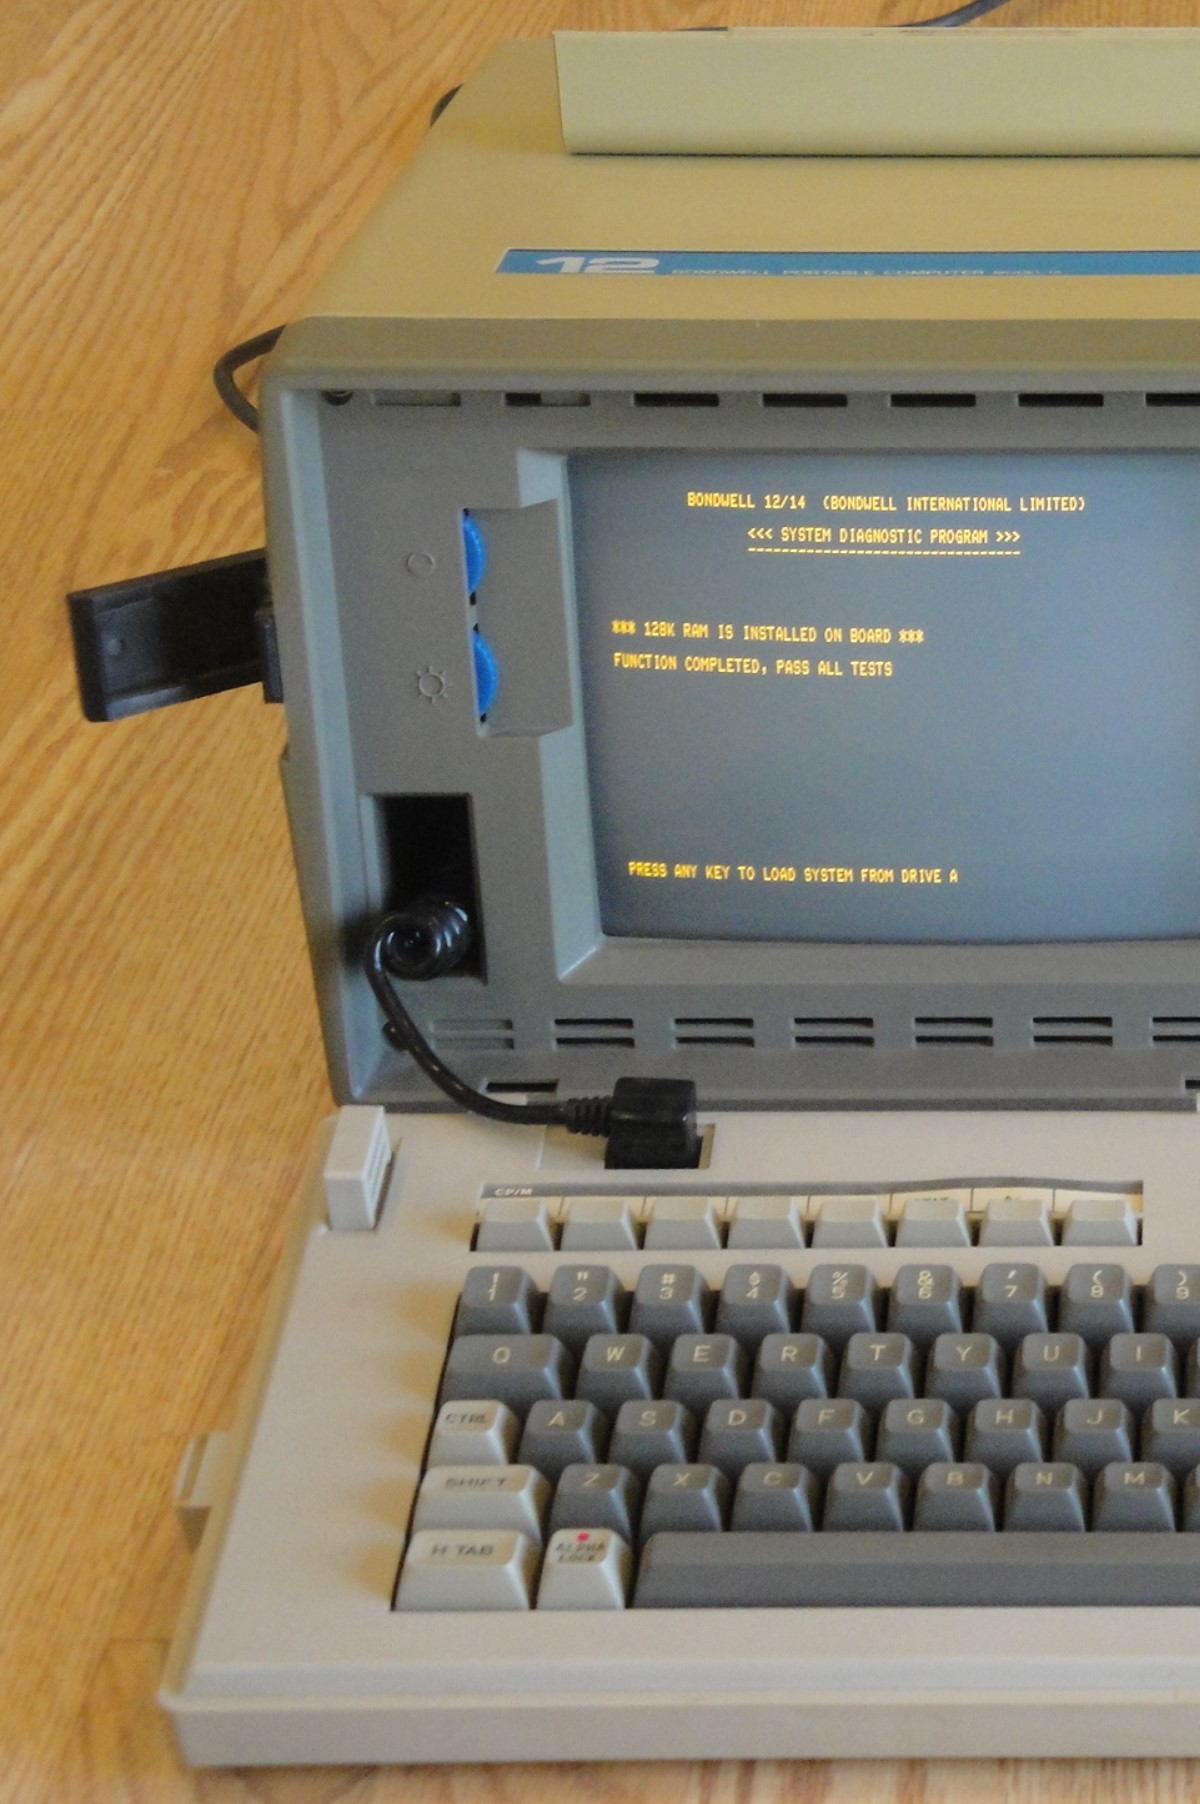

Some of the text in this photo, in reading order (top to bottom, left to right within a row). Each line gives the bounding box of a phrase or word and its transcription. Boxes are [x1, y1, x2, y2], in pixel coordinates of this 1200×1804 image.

[536, 256, 659, 275] 12
[687, 492, 1086, 512] BONDWELL 12/14 (BONDWELL INTERNATIONAL LIMITED)
[781, 527, 832, 543] SYSTEM
[839, 528, 922, 543] DIAGNOSTIC
[930, 528, 988, 544] PROGRAM
[643, 621, 676, 637] 128K
[682, 622, 709, 638] RAM
[718, 624, 734, 639] IS
[743, 625, 817, 642] INSTALLED
[824, 627, 843, 643] ON
[849, 628, 892, 644] BOARD
[613, 652, 893, 677] FUNCTION COMPLETED, PASS ALL TESTS
[628, 861, 959, 884] PRESS ANY KEY TO LOAD SYSTEM FROM DRIVE A
[494, 1187, 533, 1196] CP/M
[573, 1287, 588, 1301] 2
[659, 1287, 673, 1300] 3
[1005, 1285, 1019, 1299] 7
[606, 1346, 627, 1362] W
[694, 1345, 710, 1362] E
[781, 1345, 797, 1362] R
[869, 1344, 887, 1361] T
[956, 1345, 973, 1362] Y
[1043, 1345, 1060, 1362] U
[445, 1413, 487, 1425] CTRL
[548, 1411, 565, 1427] A
[639, 1411, 657, 1427] S
[728, 1410, 747, 1426] D
[818, 1410, 835, 1425] F
[907, 1410, 925, 1425] G
[995, 1410, 1013, 1425] H
[1086, 1410, 1103, 1425] J
[1173, 1409, 1190, 1425] K
[445, 1477, 507, 1488] SHIFT
[581, 1473, 599, 1488] Z
[672, 1473, 688, 1487] X
[763, 1472, 782, 1486] C
[856, 1472, 873, 1486] V
[946, 1471, 964, 1486] B
[1036, 1472, 1053, 1485] N
[1124, 1472, 1145, 1485] M
[431, 1544, 494, 1556] H TAB
